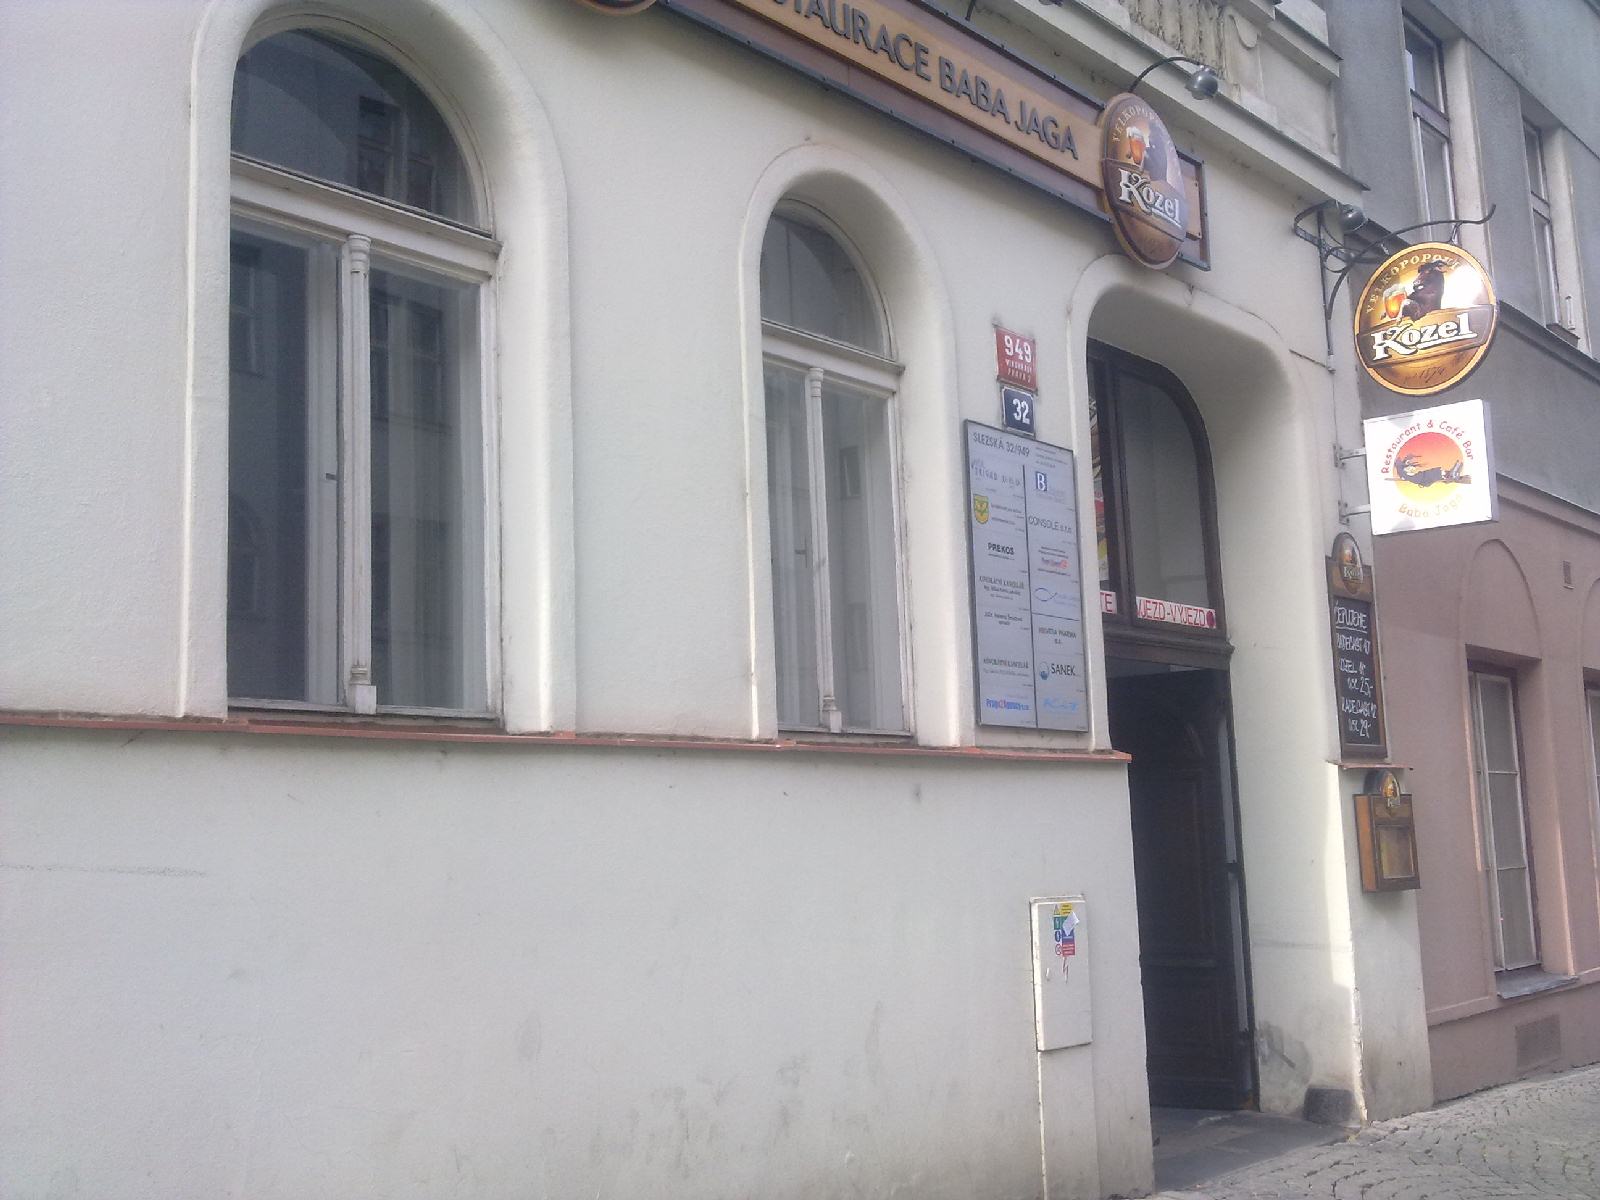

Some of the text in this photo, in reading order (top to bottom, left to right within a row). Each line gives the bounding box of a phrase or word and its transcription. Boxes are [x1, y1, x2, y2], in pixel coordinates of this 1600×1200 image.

[774, 0, 1079, 160] AURACE BABA JAGA
[1118, 167, 1181, 229] Kozel
[1003, 335, 1032, 363] 949
[1370, 312, 1478, 361] Kozel
[1012, 398, 1031, 425] 32
[1381, 419, 1474, 474] Restaurant & Café Bar
[1398, 503, 1431, 518] Baba
[987, 541, 1015, 556] PREKOS
